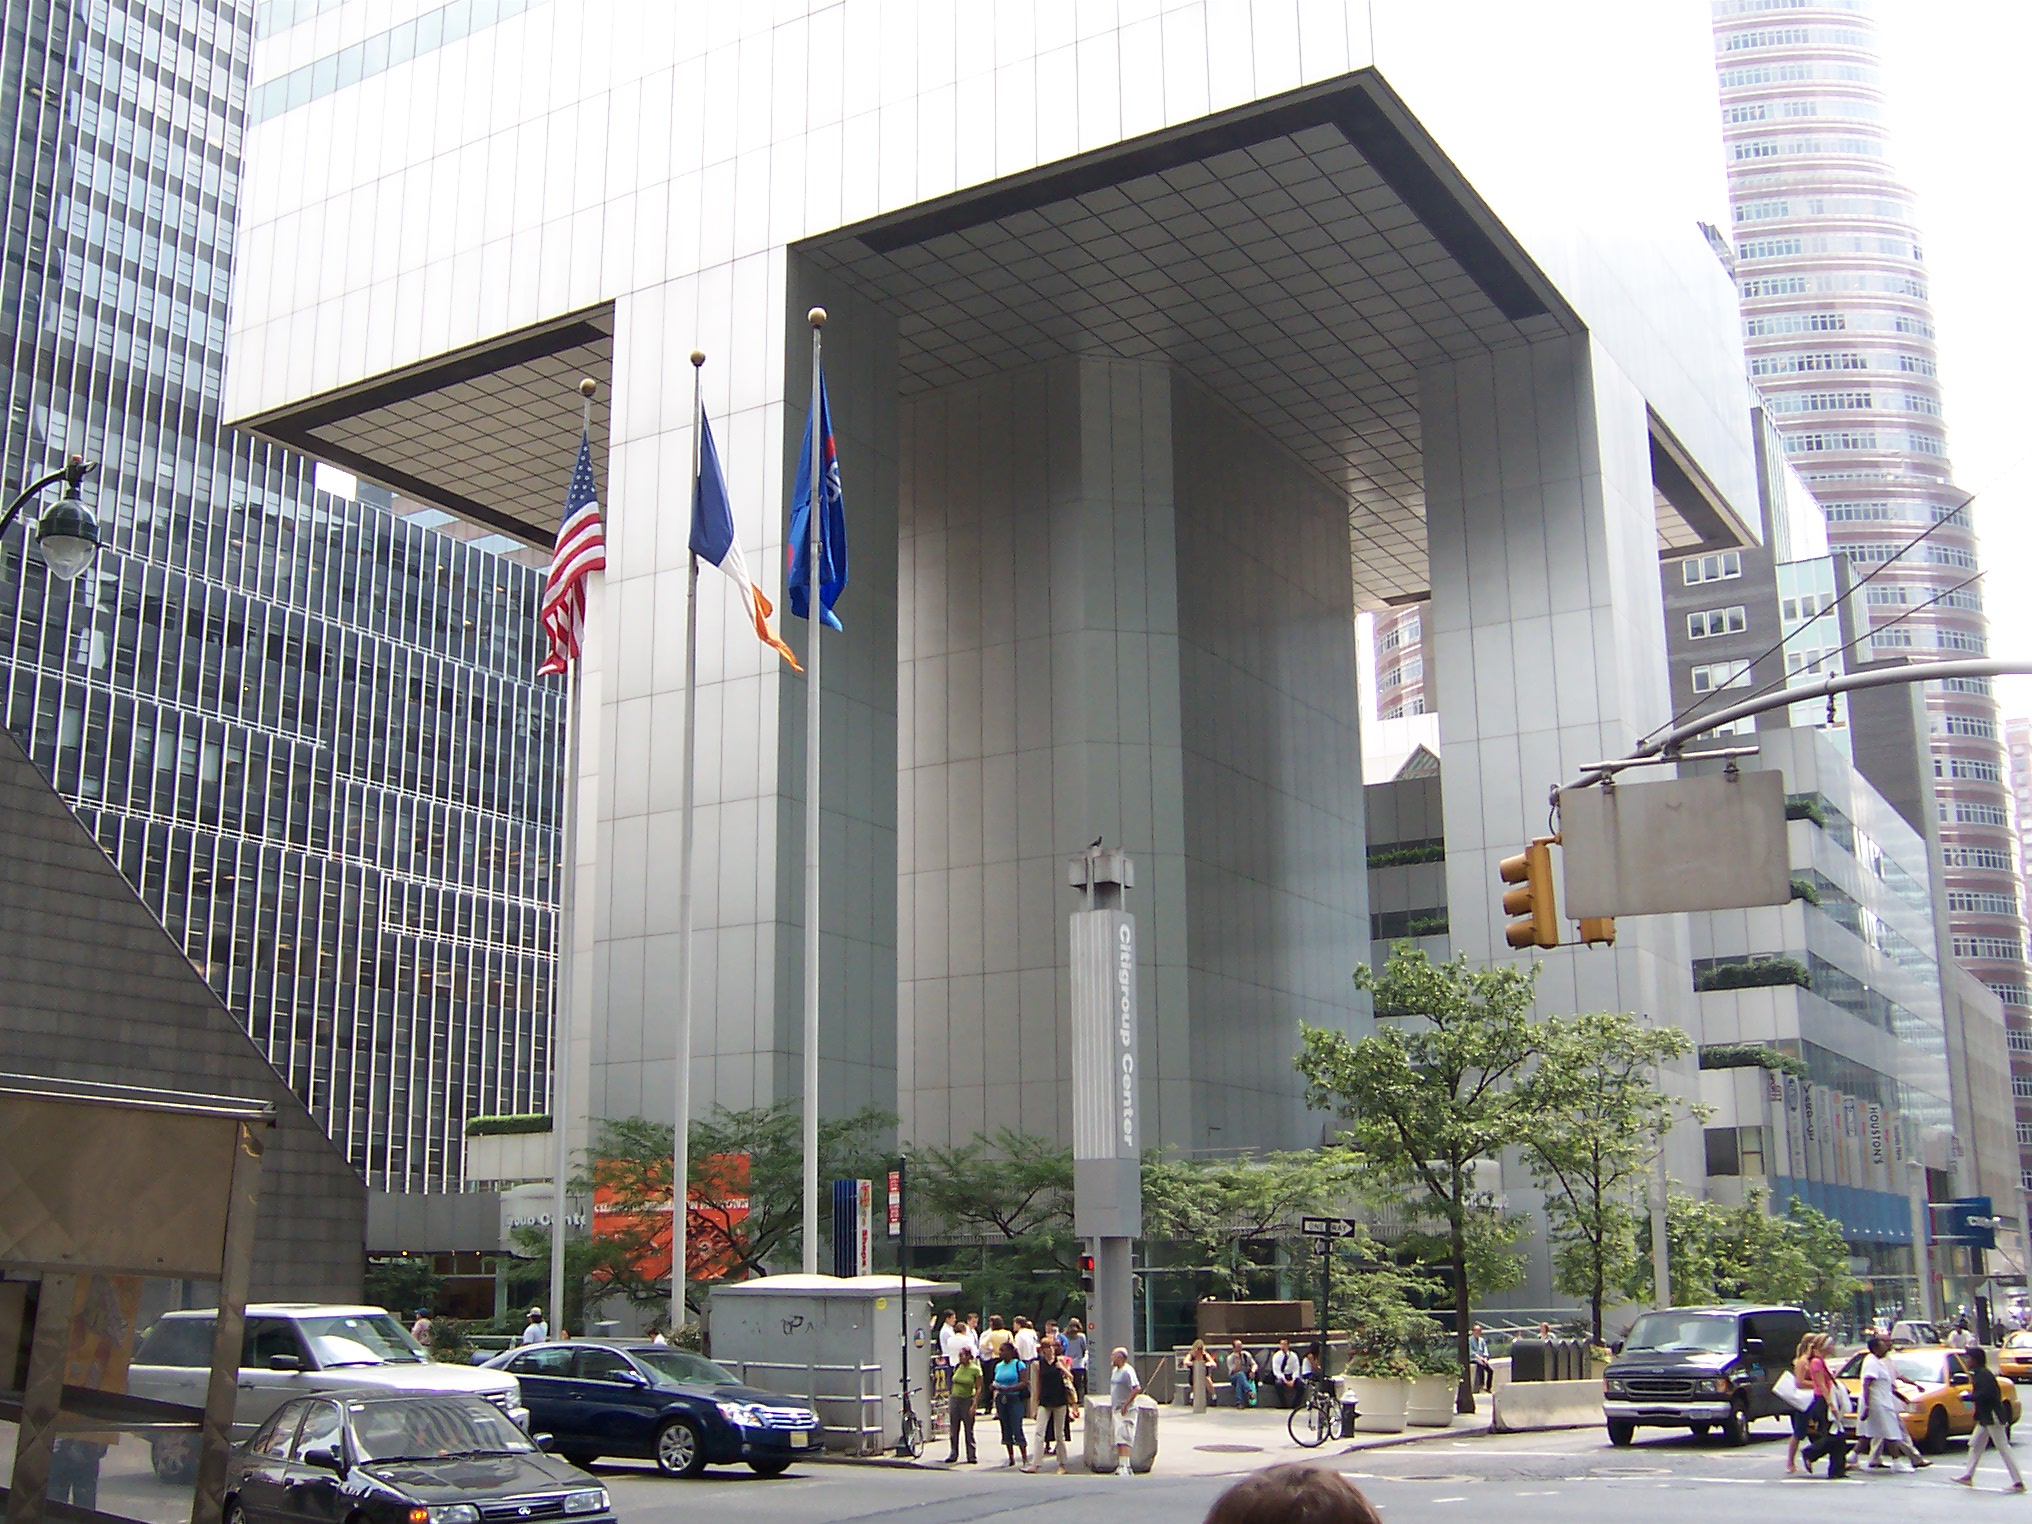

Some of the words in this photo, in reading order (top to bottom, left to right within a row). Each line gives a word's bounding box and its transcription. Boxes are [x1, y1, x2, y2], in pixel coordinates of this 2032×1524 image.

[1119, 923, 1132, 1047] Citigroup
[1122, 1053, 1134, 1147] Center
[1869, 1106, 1884, 1165] HOUSTON'S
